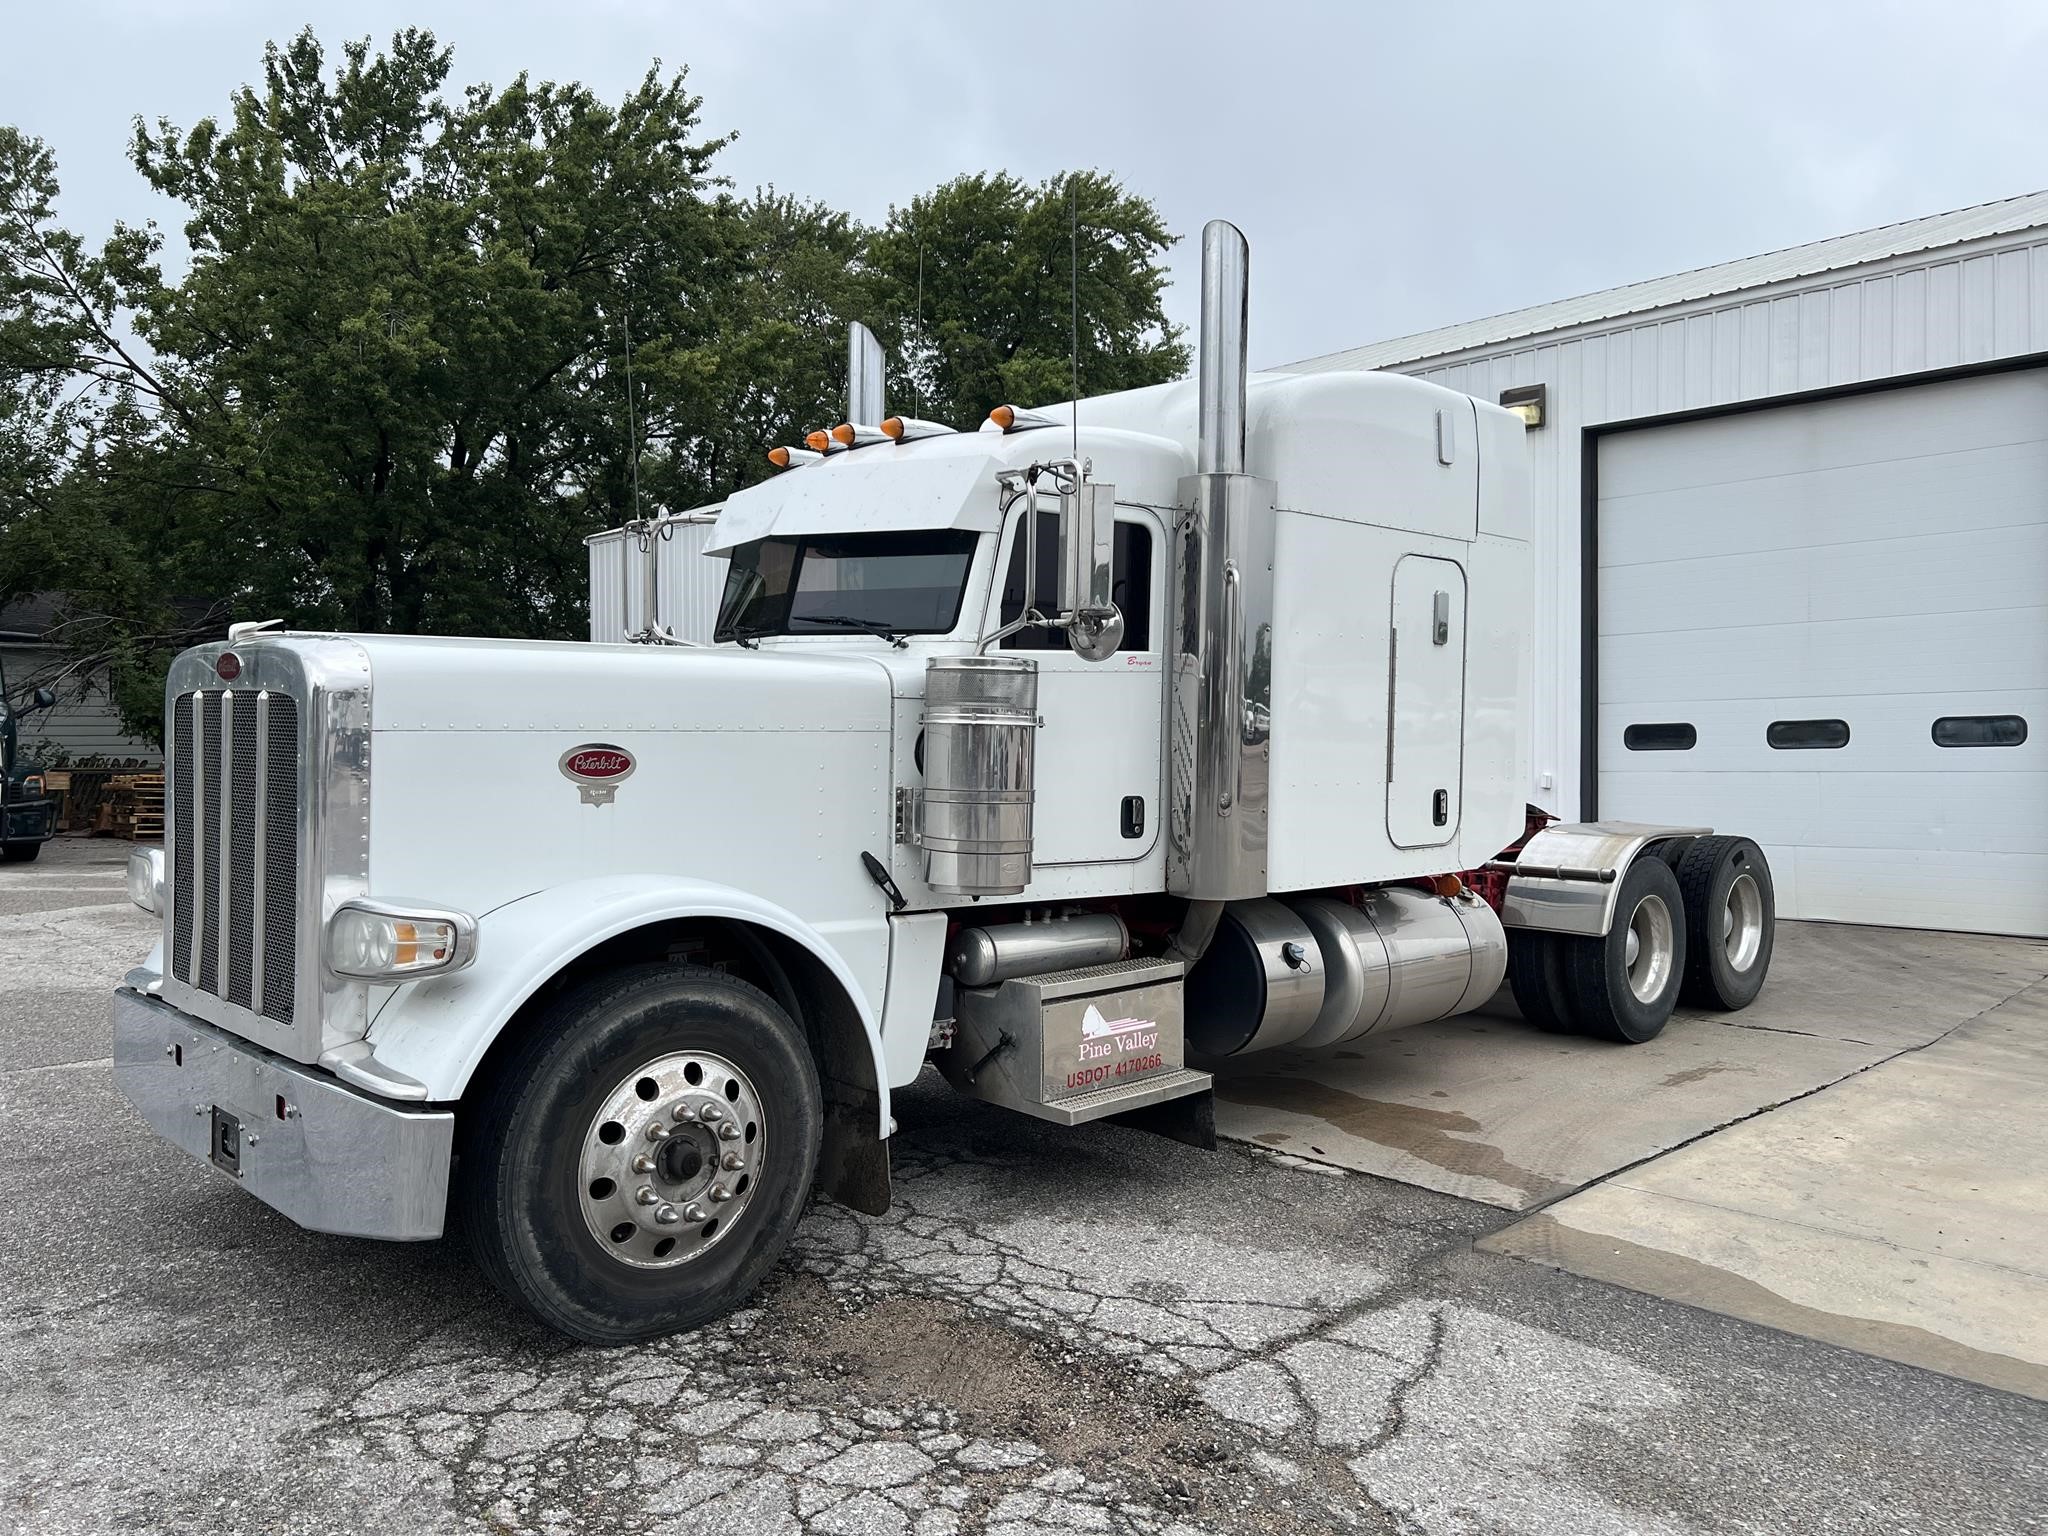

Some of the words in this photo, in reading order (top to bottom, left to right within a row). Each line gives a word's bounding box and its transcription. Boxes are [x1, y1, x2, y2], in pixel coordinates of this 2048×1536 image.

[574, 754, 626, 771] Peterbilt
[1078, 1042, 1112, 1062] Pine
[1114, 1031, 1159, 1053] Valley
[1067, 1064, 1112, 1089] USDOT
[1115, 1053, 1162, 1076] 4170266
